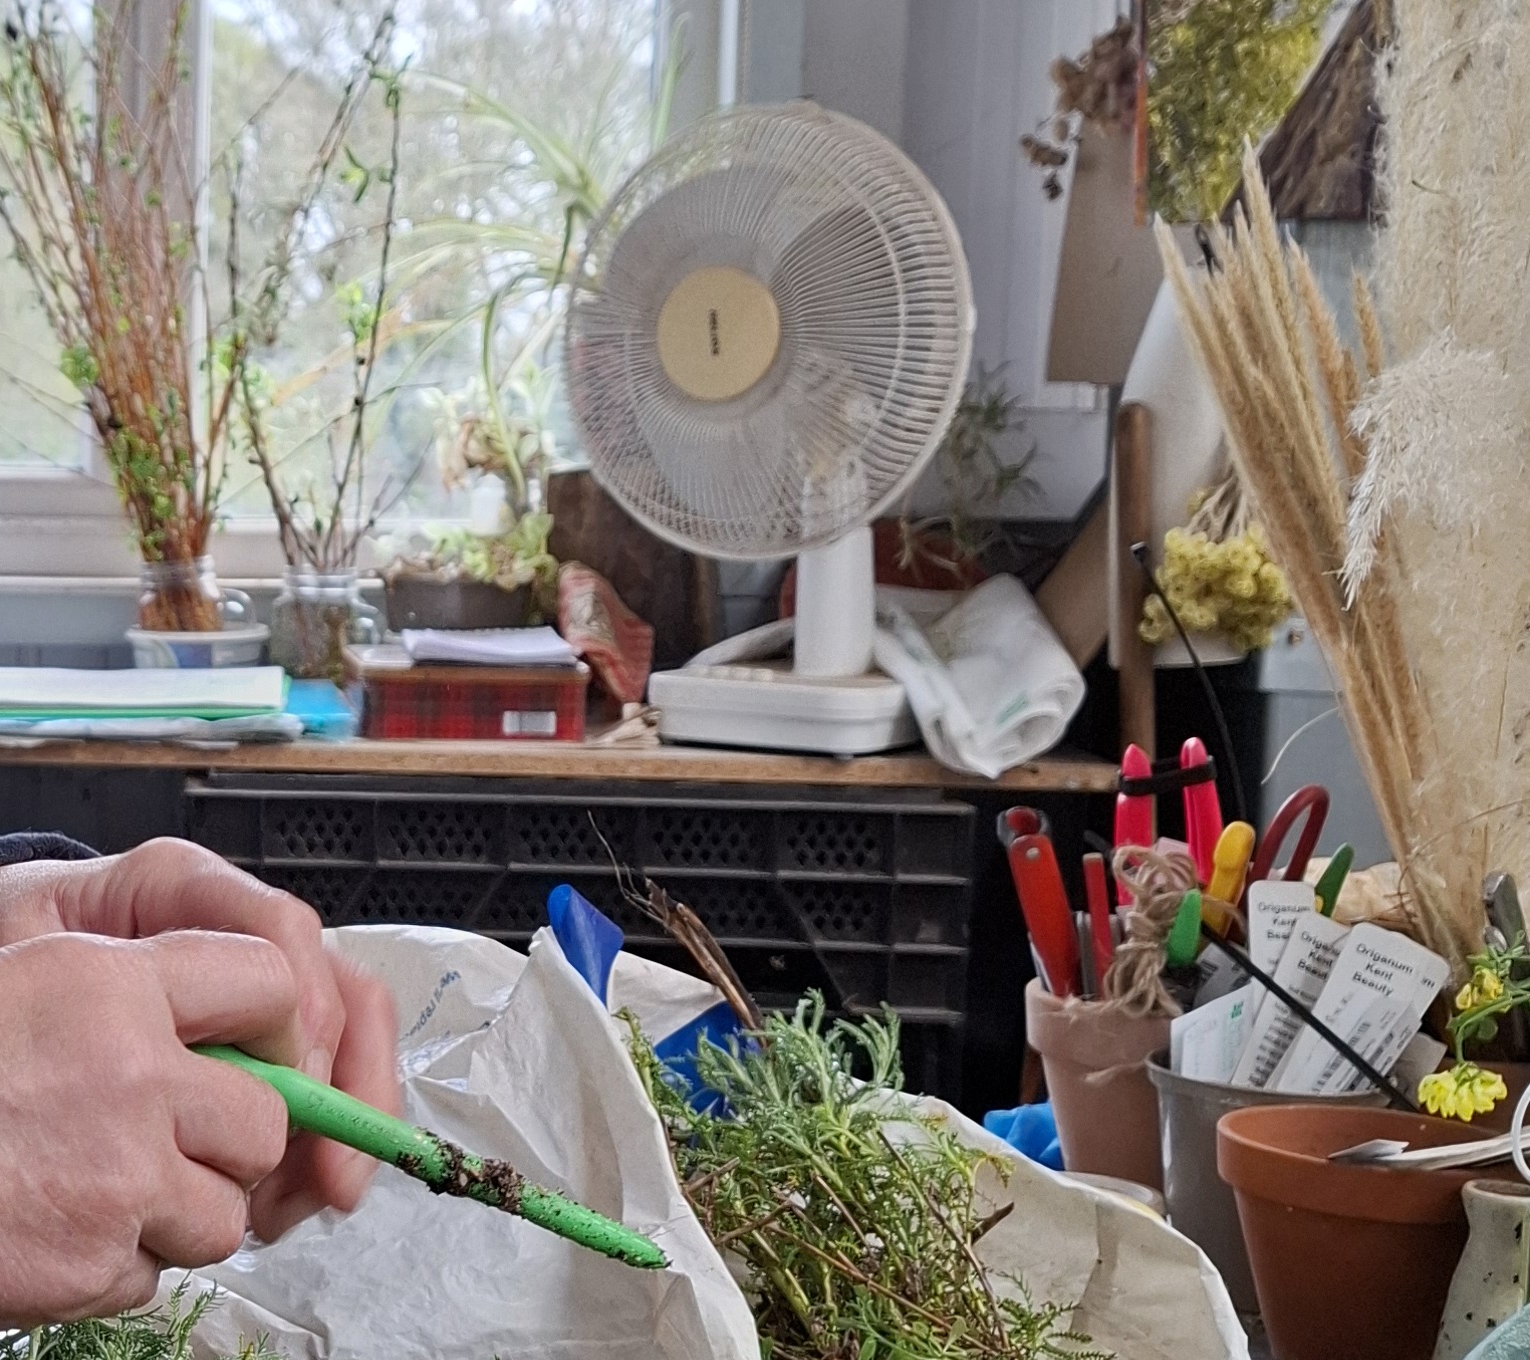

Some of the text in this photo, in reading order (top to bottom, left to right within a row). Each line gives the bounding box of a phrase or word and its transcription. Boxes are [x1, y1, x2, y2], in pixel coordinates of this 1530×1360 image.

[1301, 930, 1340, 956] Origanu
[1297, 959, 1328, 981] Beaut
[1356, 942, 1414, 975] Origanum
[1352, 971, 1395, 997] Beauty
[1365, 963, 1394, 981] Kent
